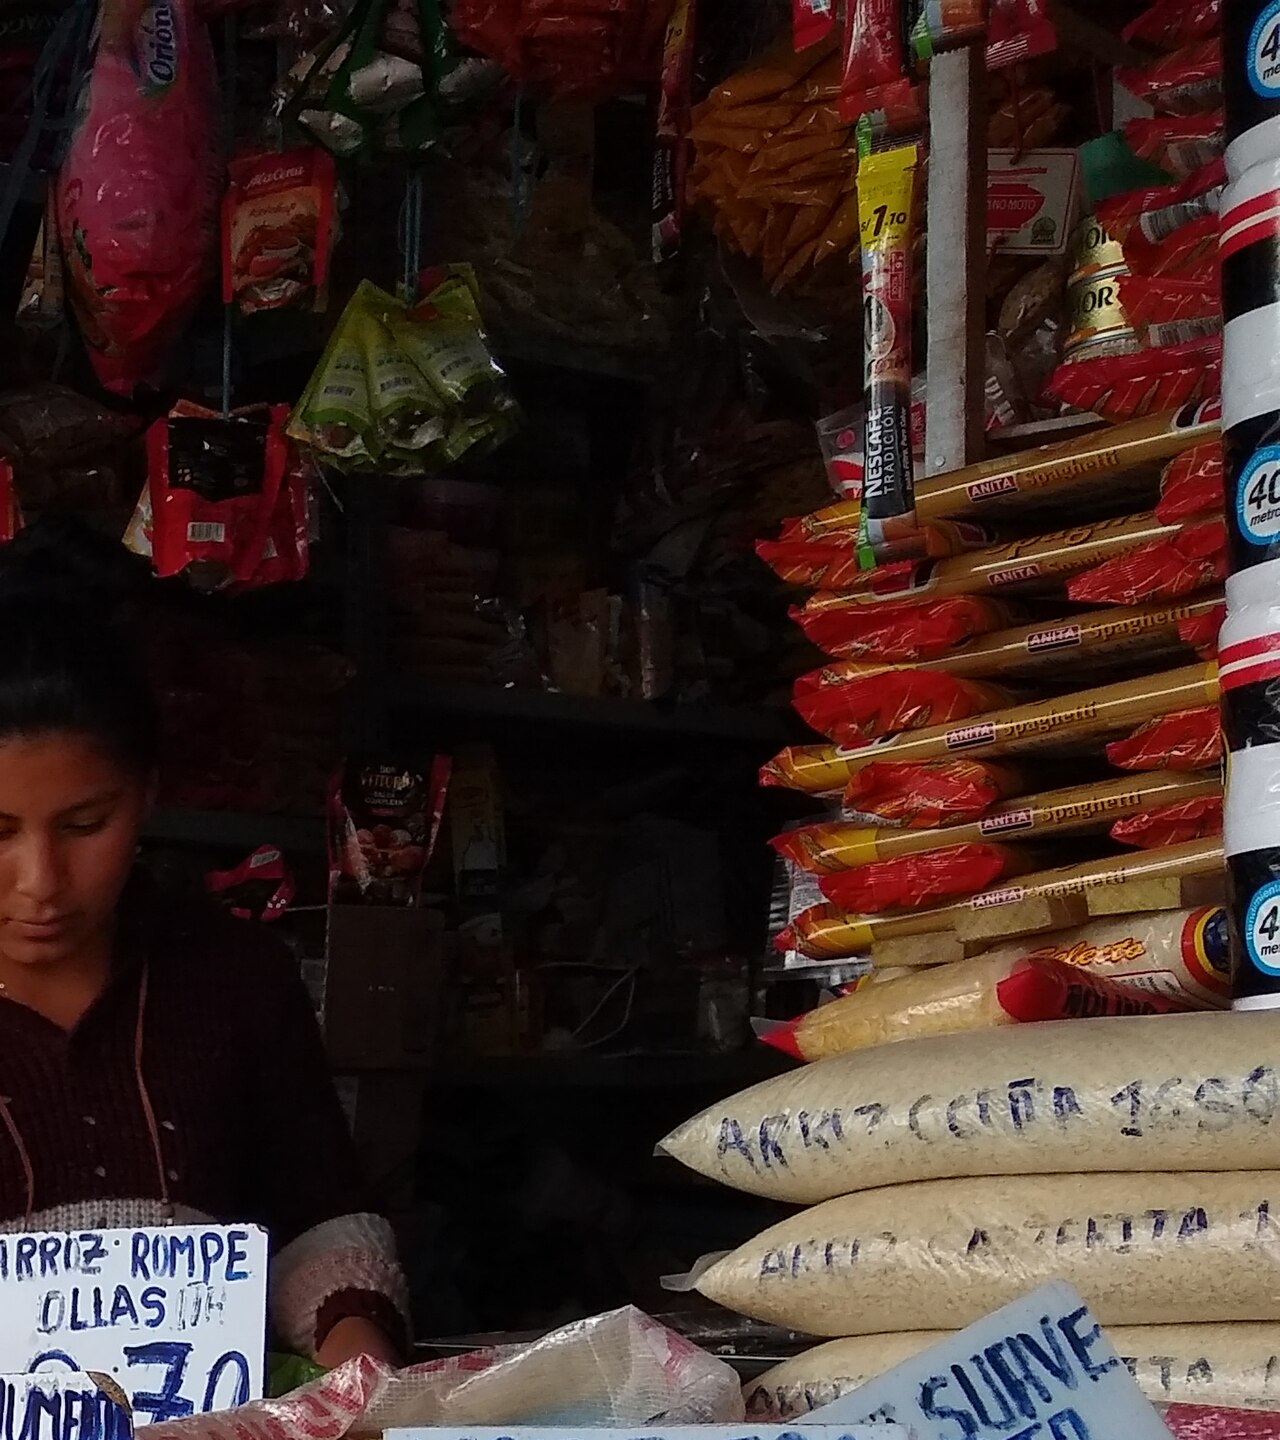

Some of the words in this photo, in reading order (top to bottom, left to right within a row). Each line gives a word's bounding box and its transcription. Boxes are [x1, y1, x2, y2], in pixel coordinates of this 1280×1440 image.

[1260, 22, 1280, 62] 4
[881, 404, 896, 496] TRADICIÓN
[970, 477, 1016, 498] ANITA
[1024, 450, 1121, 488] Spaghetti
[990, 566, 1037, 585] ANITA
[1028, 626, 1081, 647] ANITA
[1089, 605, 1191, 640] Spaghetti
[949, 724, 994, 744] ANITA
[1003, 700, 1099, 736] Spaghetti
[982, 810, 1031, 830] ANITA
[1040, 792, 1142, 823] Spaghetti
[973, 888, 1022, 907] ANITA
[1258, 905, 1280, 941] 4
[130, 1230, 251, 1282] ROMPE
[37, 1284, 167, 1334] OLLAS
